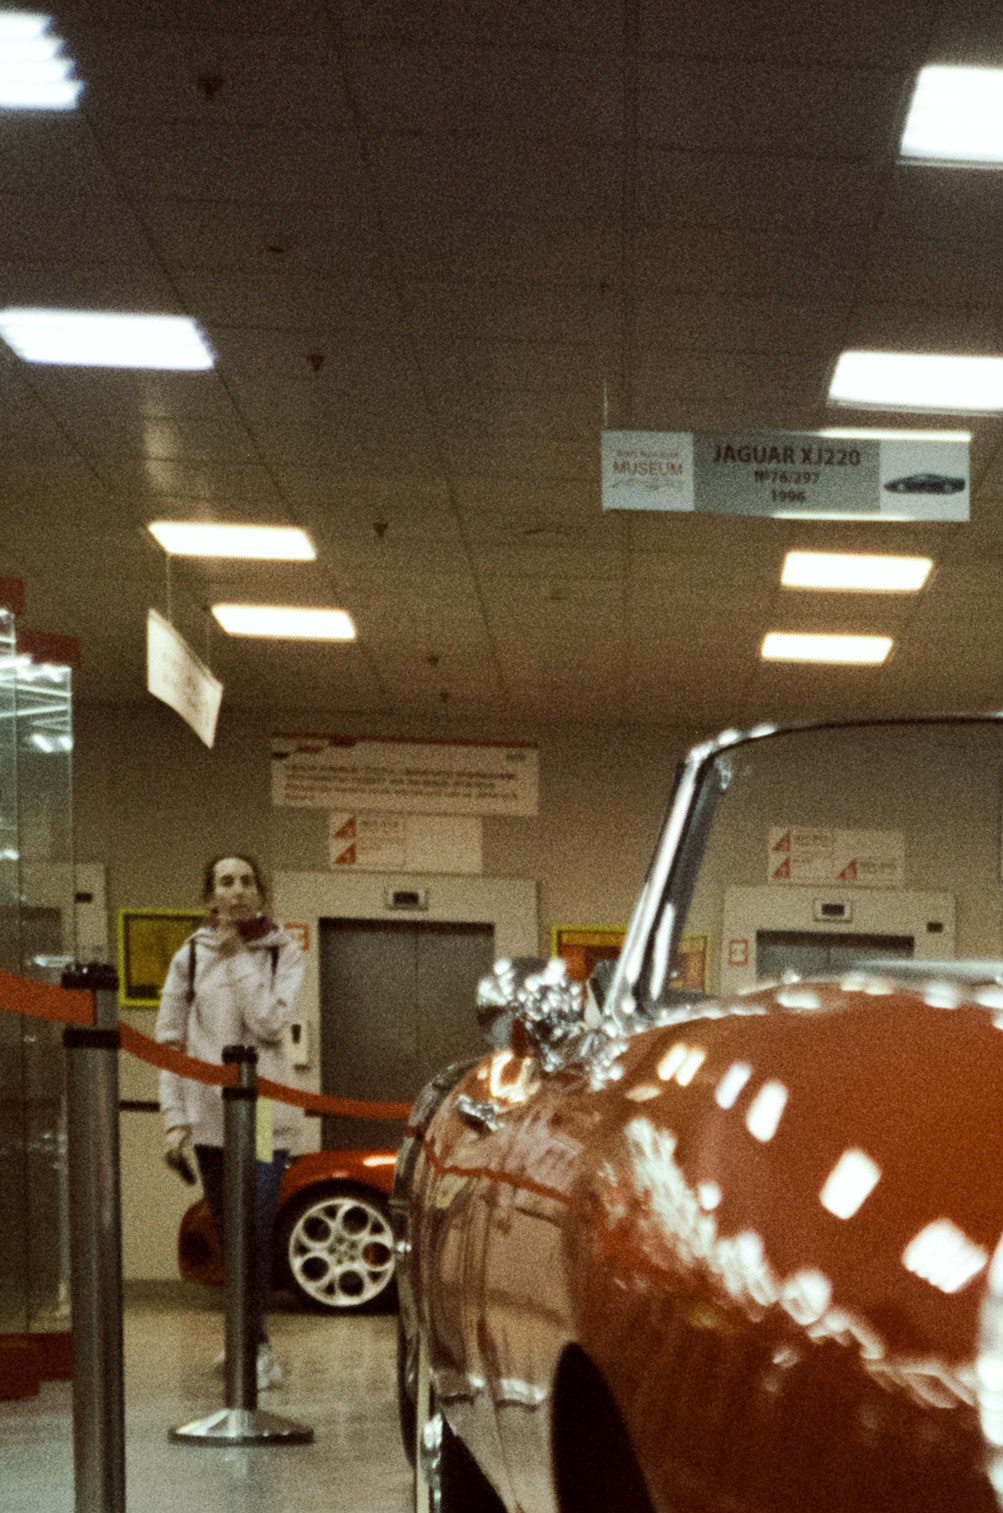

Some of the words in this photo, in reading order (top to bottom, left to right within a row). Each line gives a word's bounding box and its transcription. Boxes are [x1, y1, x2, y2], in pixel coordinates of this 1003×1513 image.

[713, 444, 795, 464] JAGUAR
[801, 447, 861, 467] XJ220
[612, 460, 683, 476] MUSEUM
